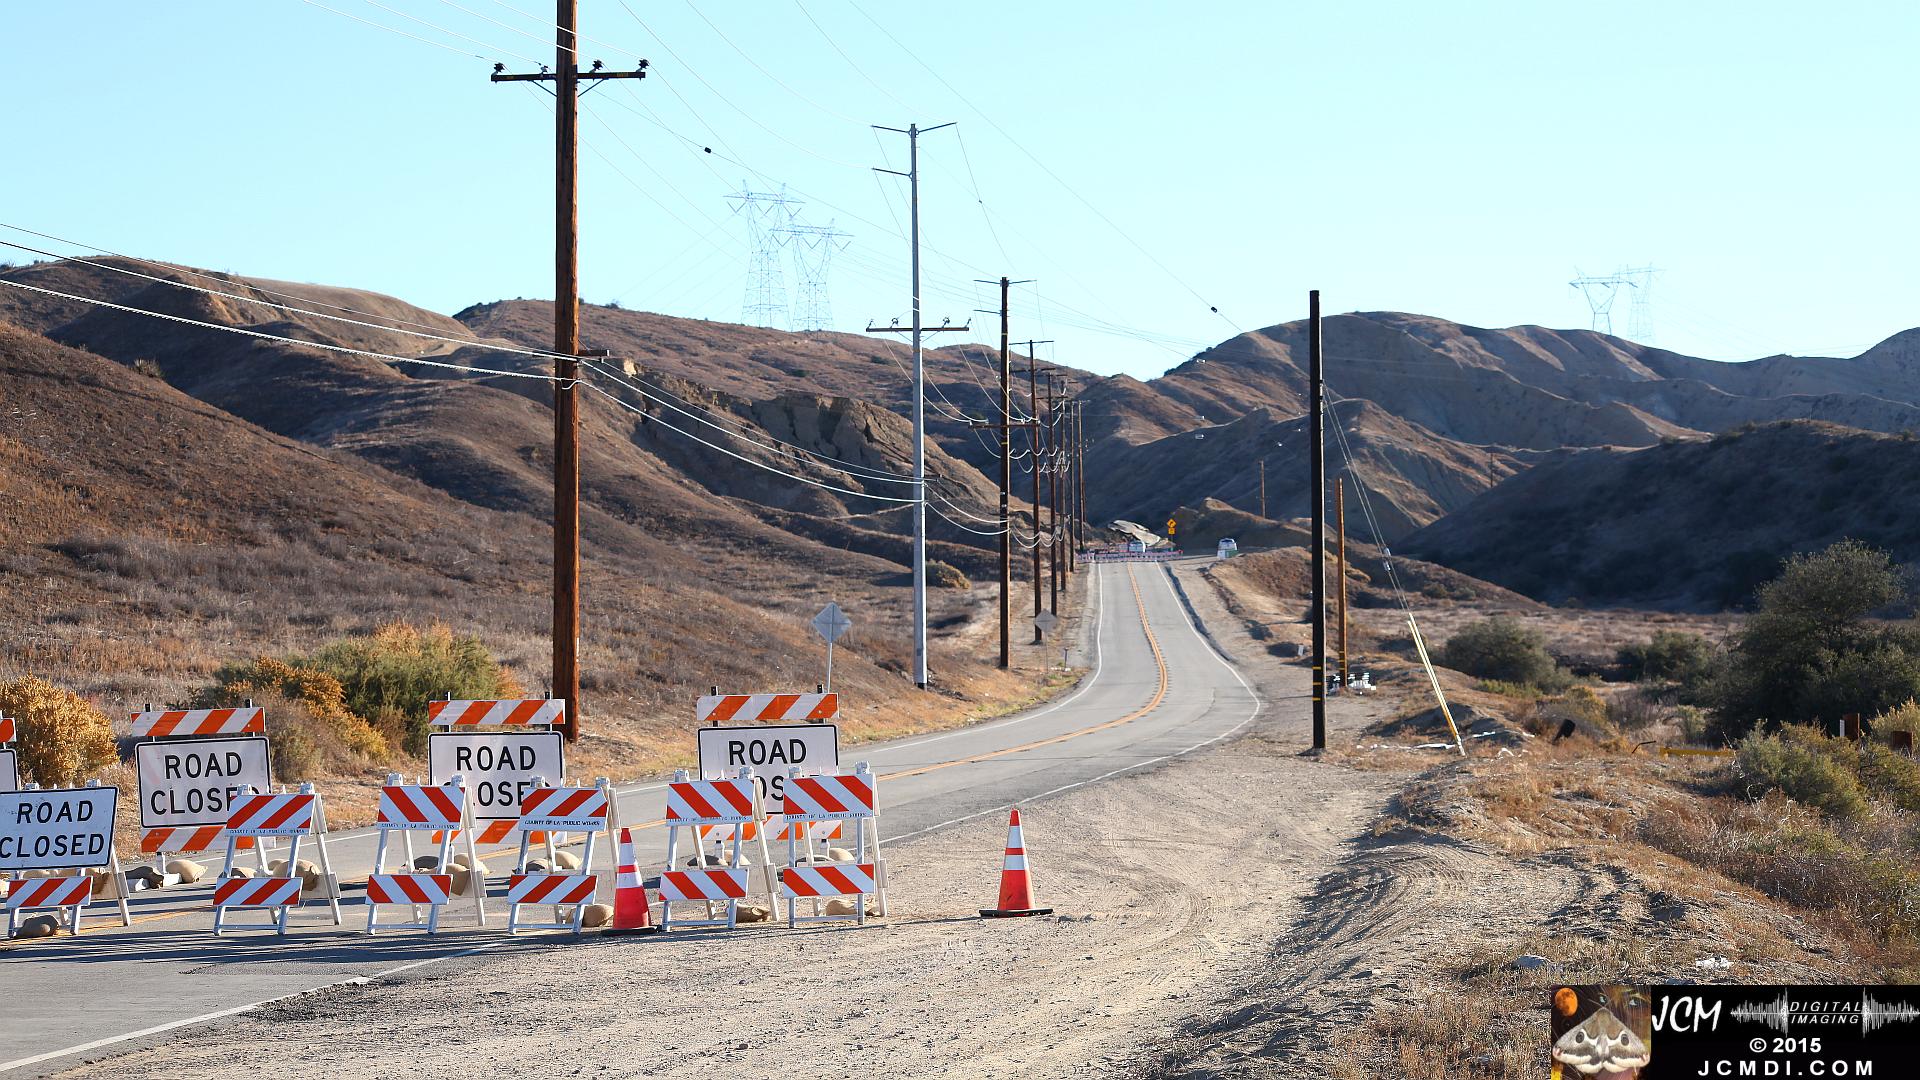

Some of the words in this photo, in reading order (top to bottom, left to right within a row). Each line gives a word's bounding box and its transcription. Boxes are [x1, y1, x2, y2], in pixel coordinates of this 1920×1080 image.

[164, 751, 243, 779] ROAD
[456, 745, 537, 771] ROAD
[728, 738, 807, 766] ROAD
[150, 786, 260, 815] CLOSE
[443, 780, 551, 806] OSE
[16, 800, 93, 824] ROAD
[0, 833, 105, 858] CLOSED
